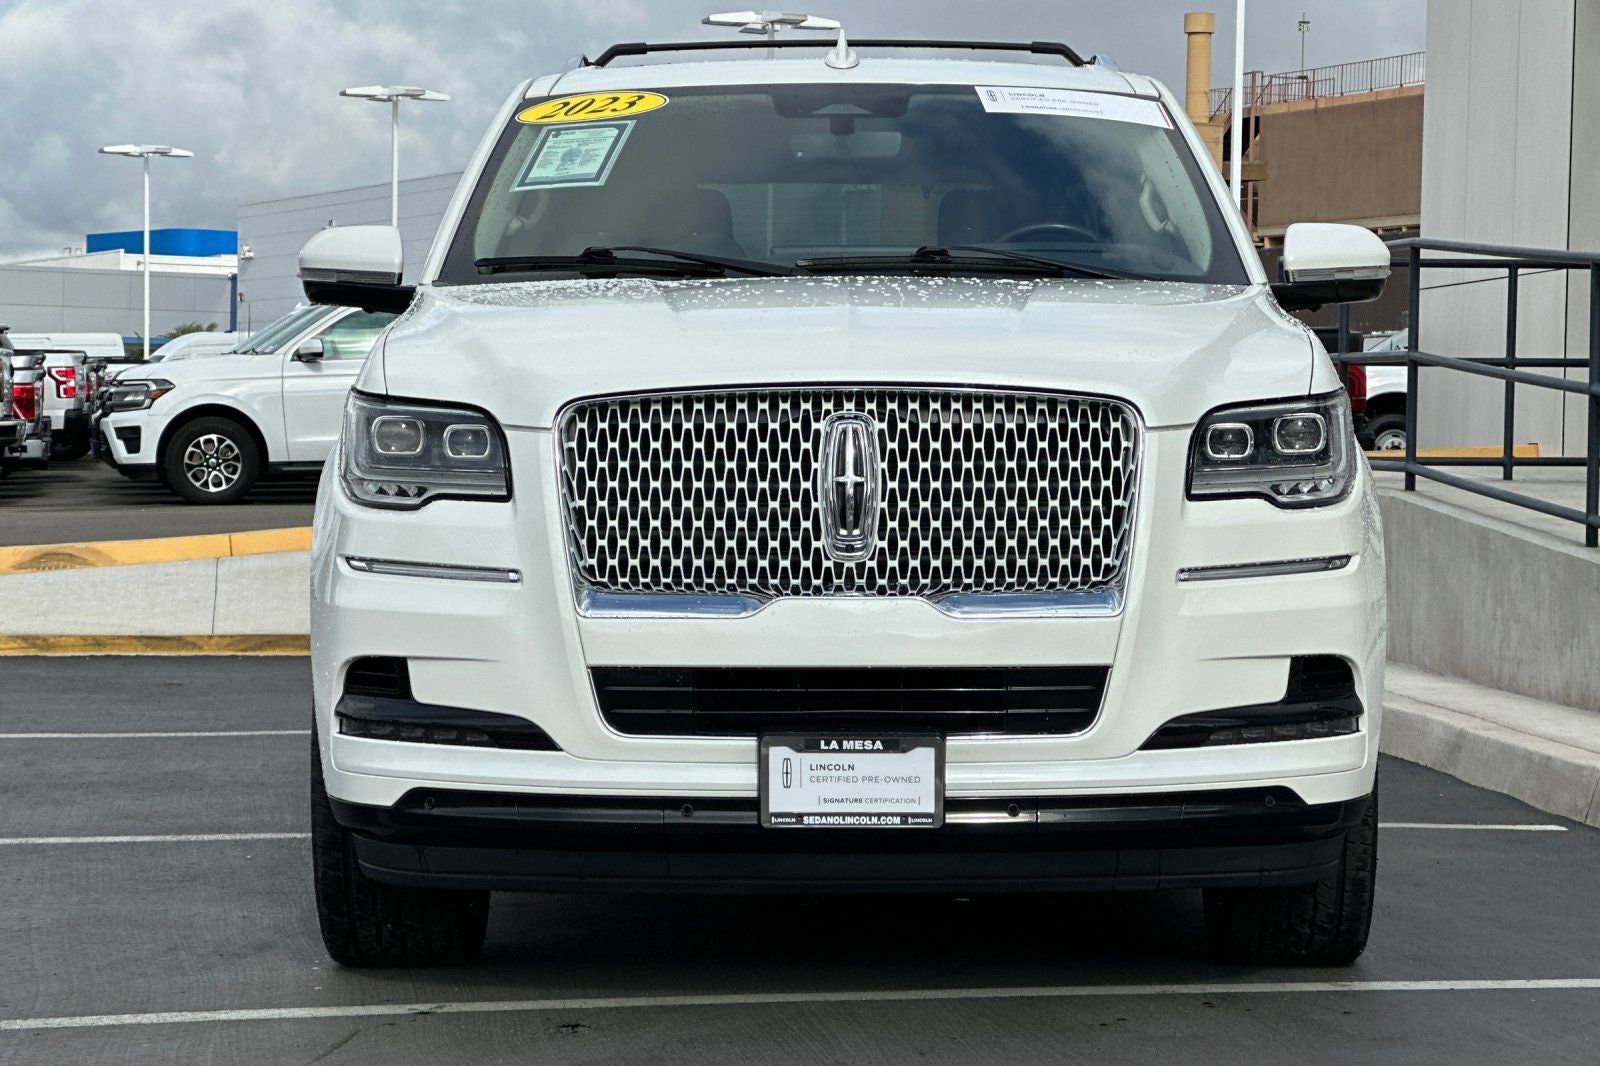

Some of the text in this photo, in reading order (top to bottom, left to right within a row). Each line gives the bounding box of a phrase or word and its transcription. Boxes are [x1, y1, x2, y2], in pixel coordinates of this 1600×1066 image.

[536, 95, 645, 120] 2023
[820, 740, 883, 750] LA MESA
[809, 763, 855, 771] LINCOLN
[809, 775, 921, 784] CERTIFIED PRE-OWNED
[803, 816, 900, 825] SEDANOLINCOLN.COM
